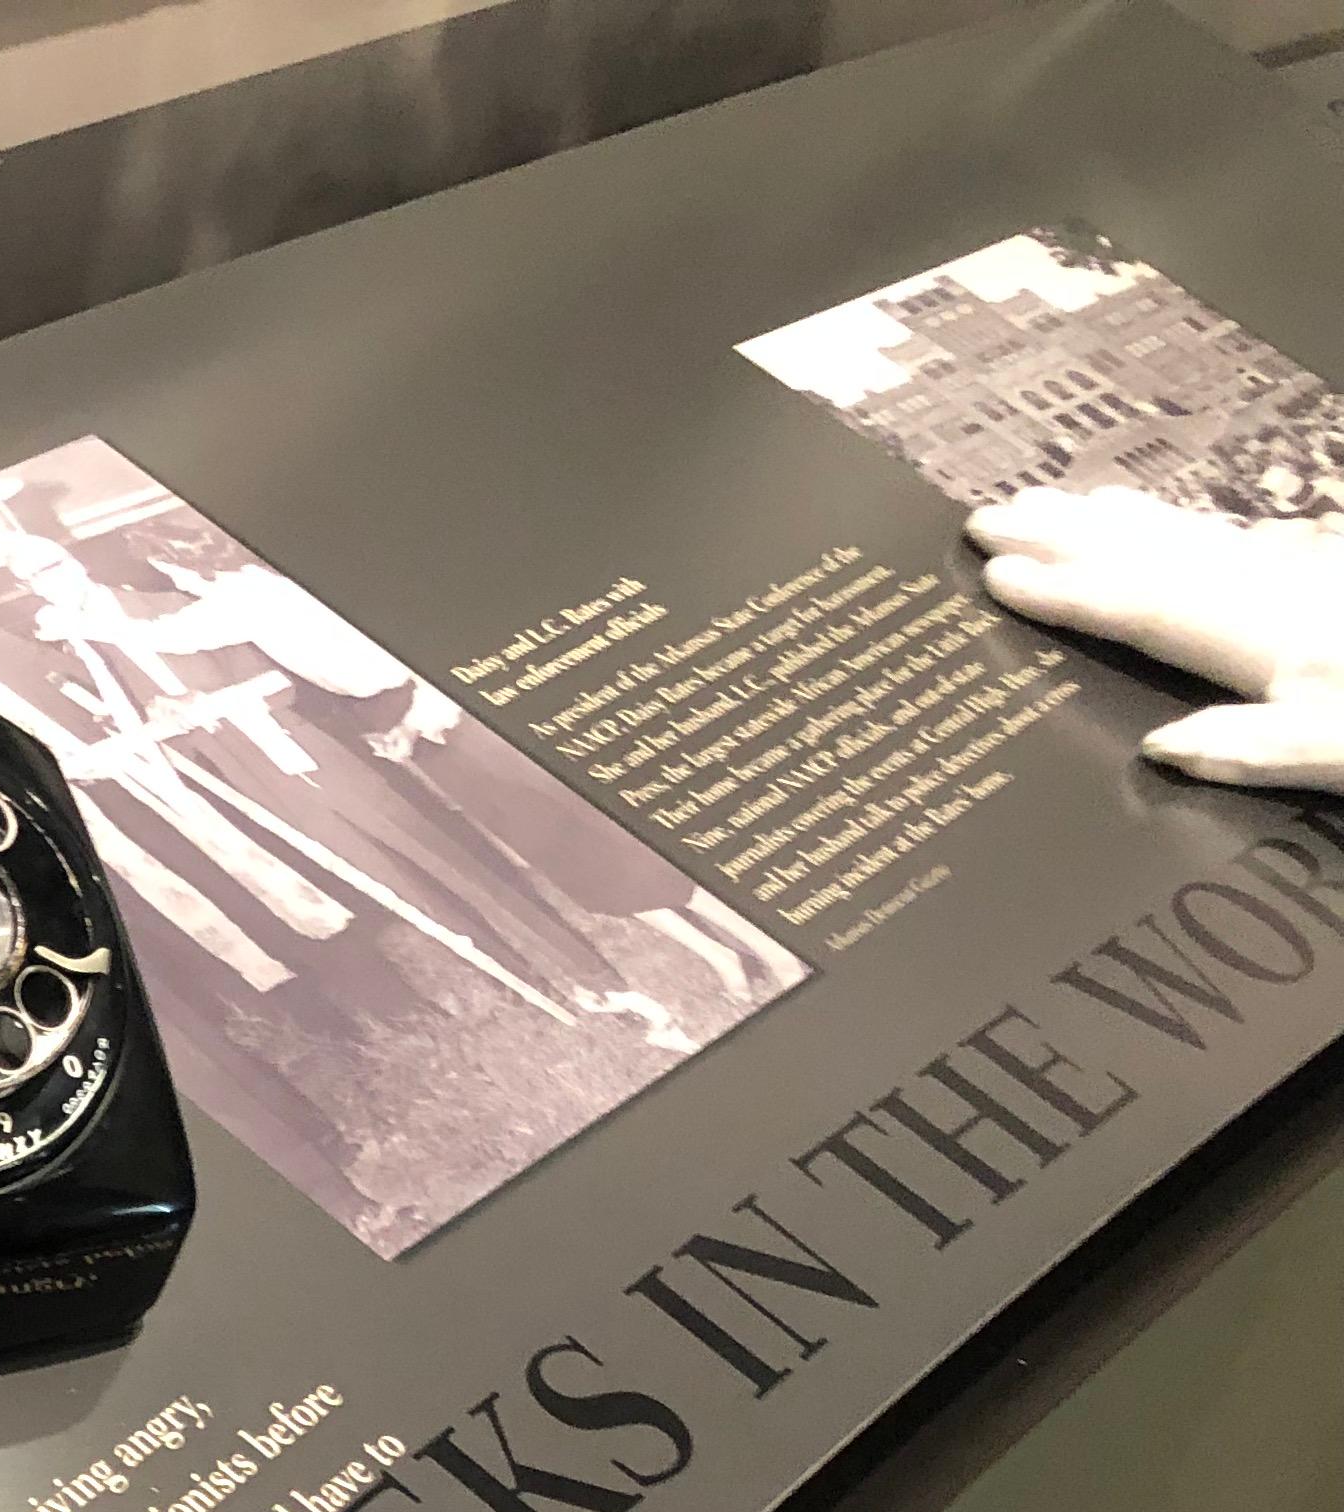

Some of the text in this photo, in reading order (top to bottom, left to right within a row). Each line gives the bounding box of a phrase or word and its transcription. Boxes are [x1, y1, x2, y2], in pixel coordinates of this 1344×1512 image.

[623, 1194, 879, 1399] IN
[789, 1005, 1139, 1250] THE
[1049, 815, 1344, 1050] WOR
[113, 1396, 210, 1467] angry,
[237, 1384, 342, 1458] before
[363, 1435, 405, 1466] to
